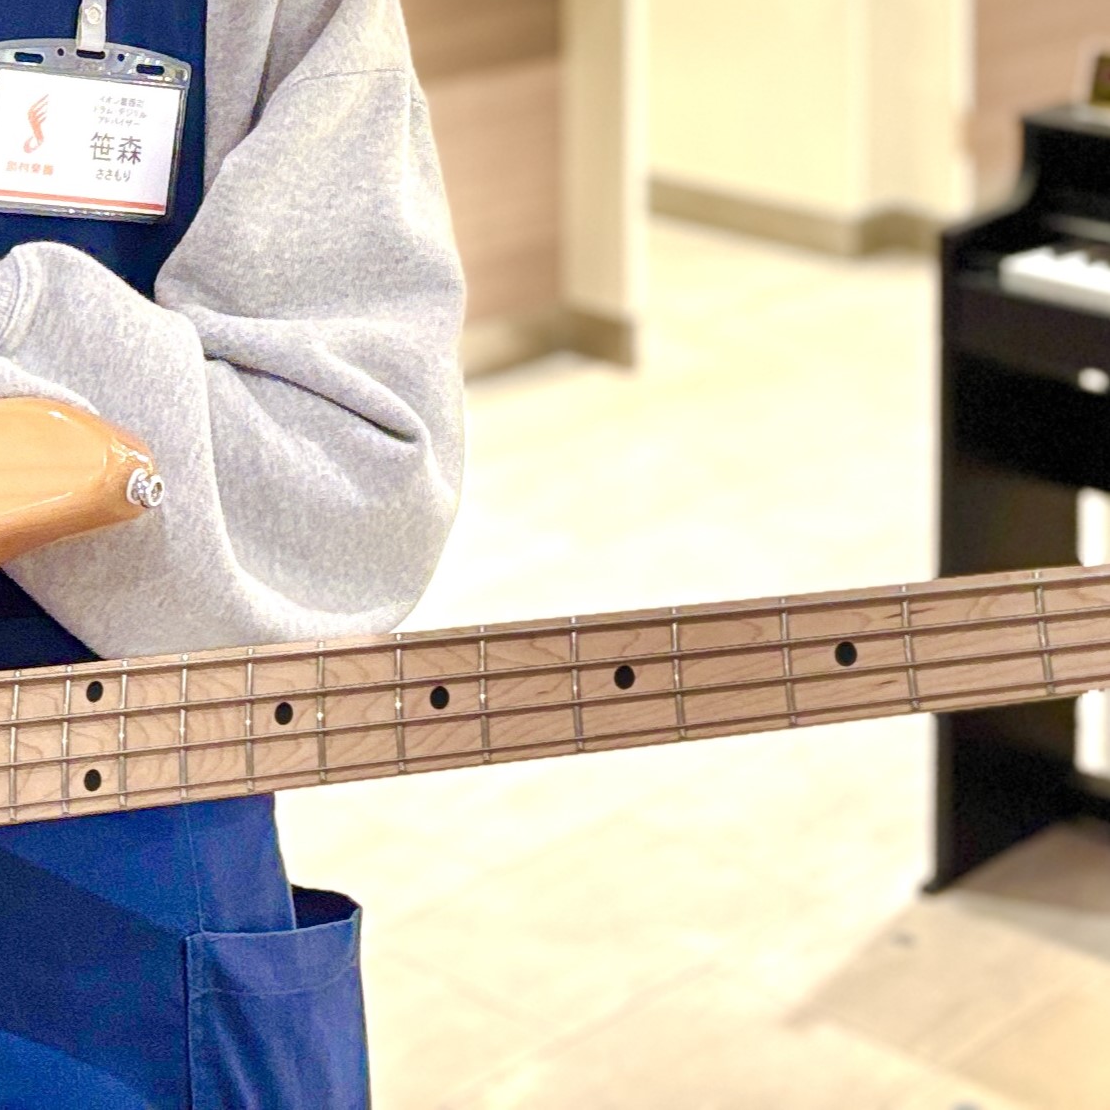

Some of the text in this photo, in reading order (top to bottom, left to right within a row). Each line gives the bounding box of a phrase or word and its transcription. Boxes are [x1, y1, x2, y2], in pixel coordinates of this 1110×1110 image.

[90, 132, 142, 165] 笹森
[95, 168, 132, 183] ささもり
